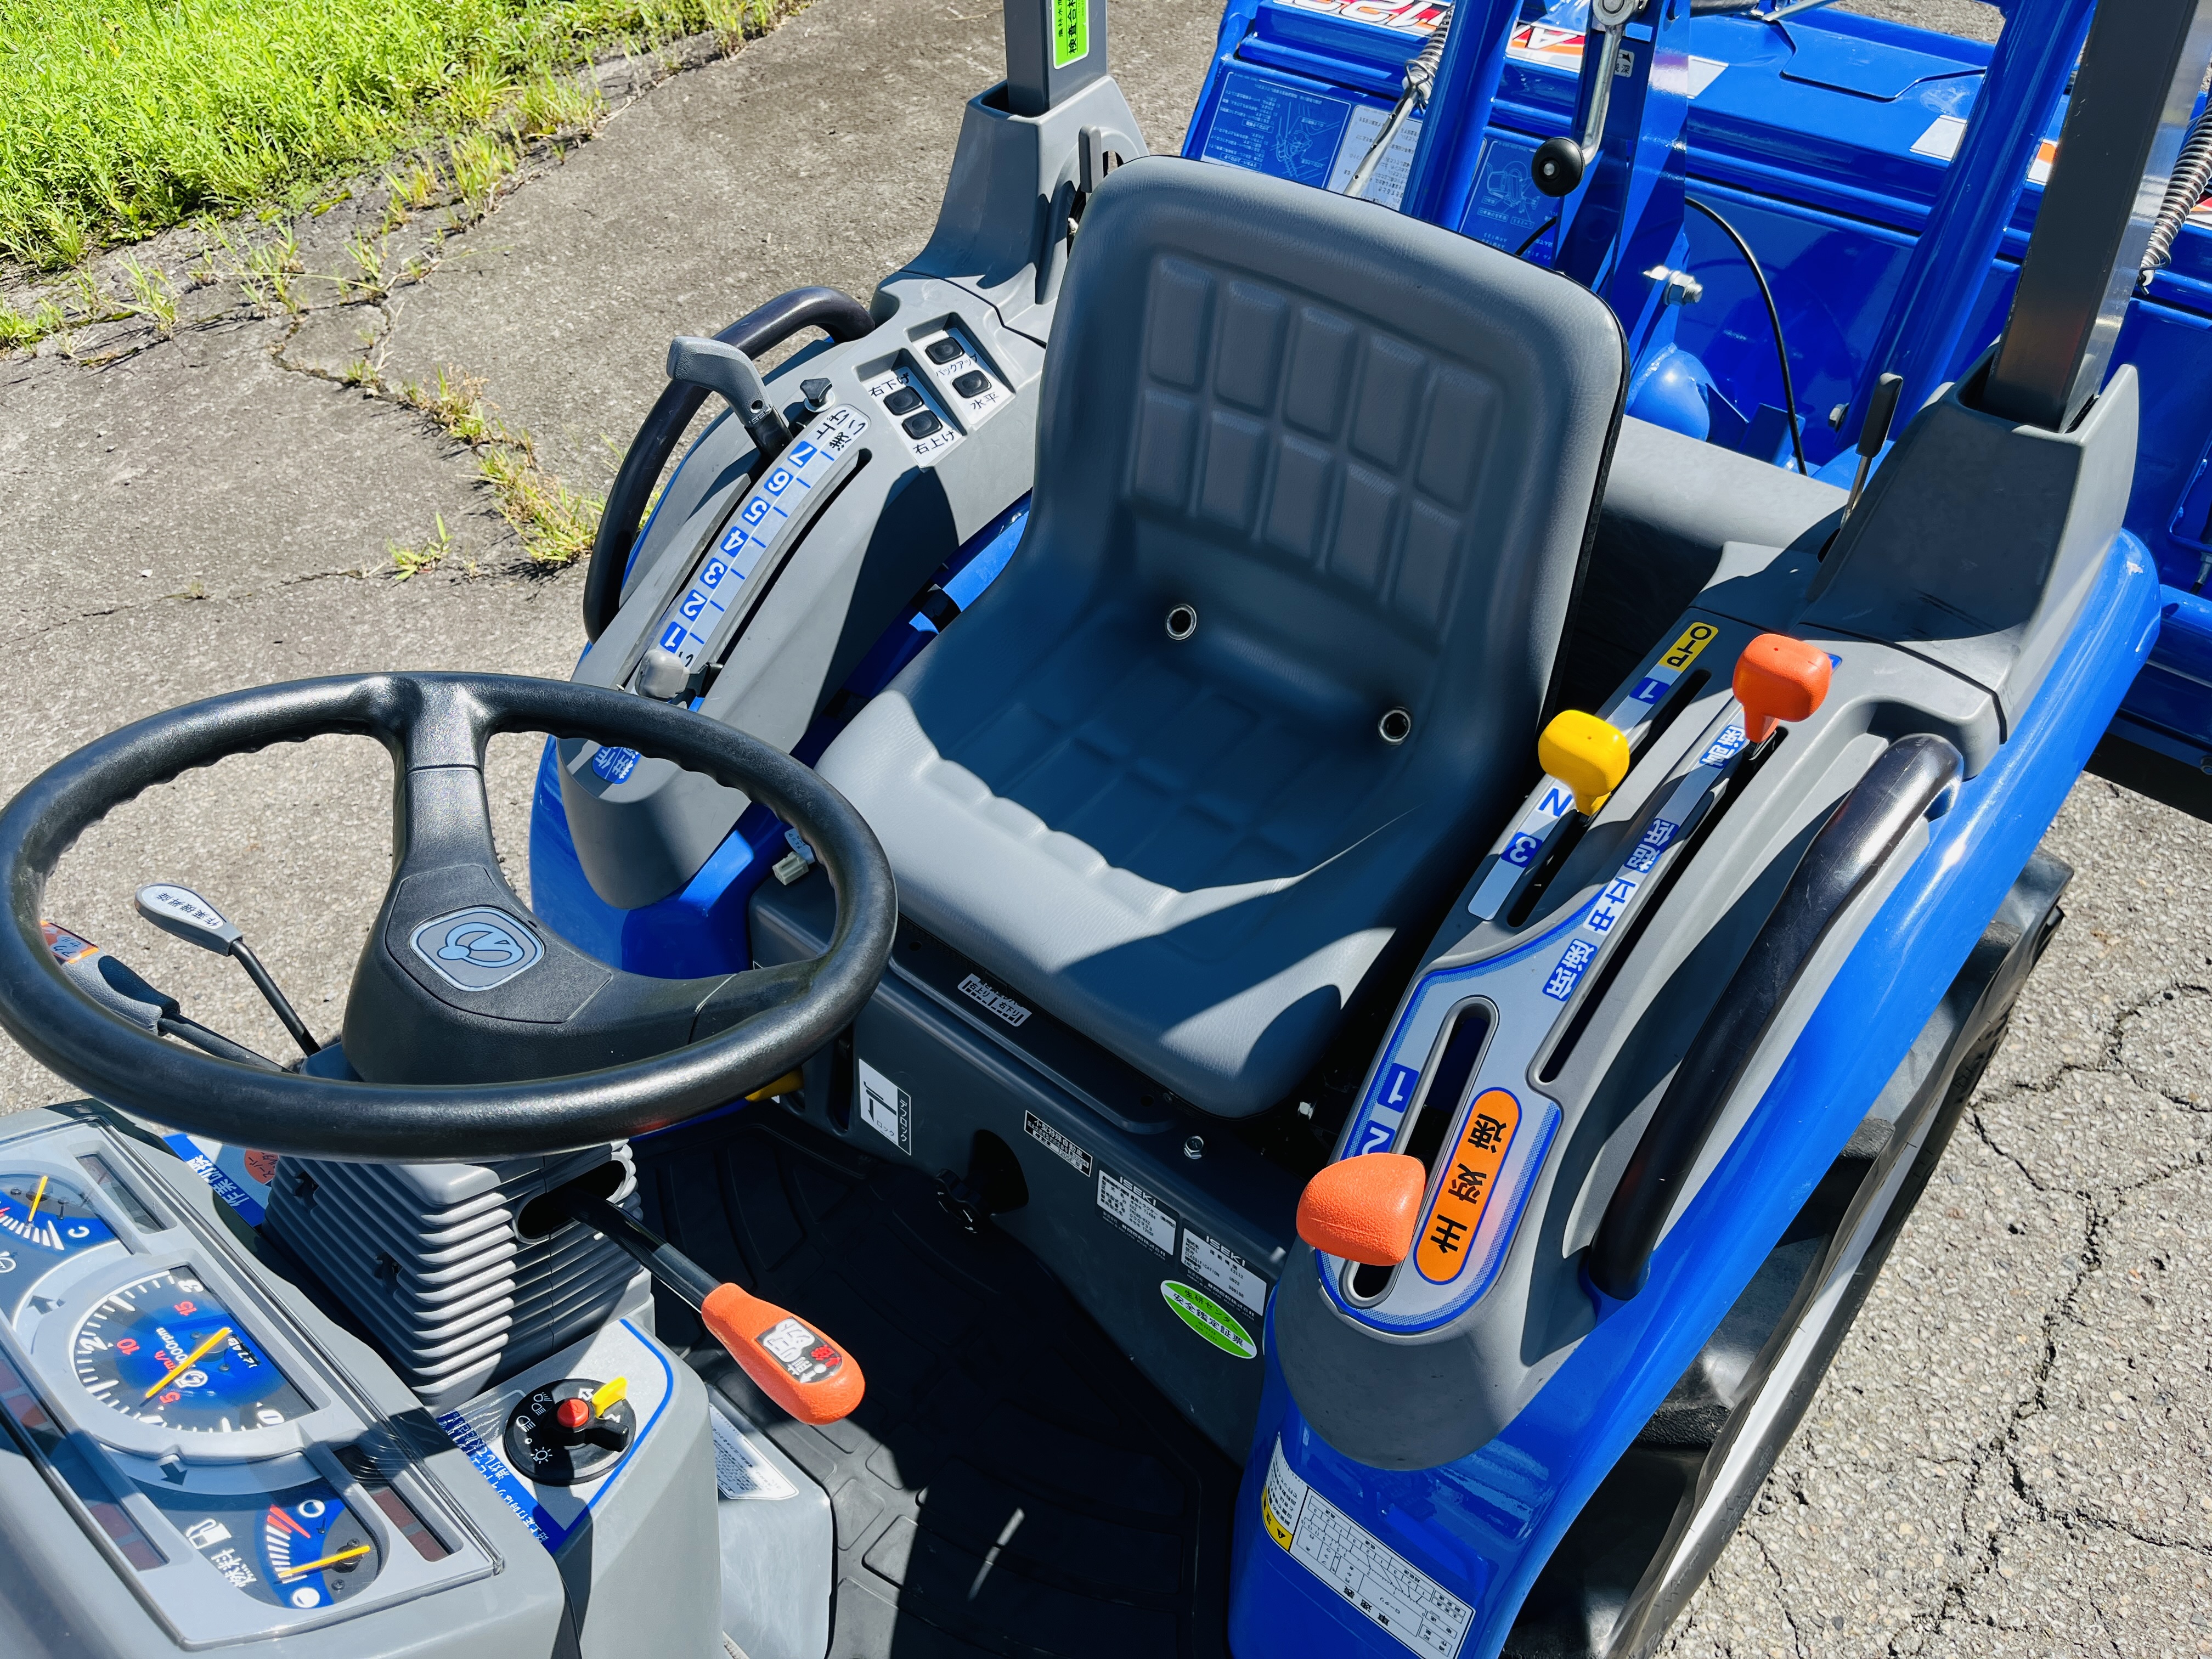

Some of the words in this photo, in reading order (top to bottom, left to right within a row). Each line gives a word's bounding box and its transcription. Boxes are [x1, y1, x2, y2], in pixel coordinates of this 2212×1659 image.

[935, 353, 978, 379] バックアップ
[868, 370, 911, 398] 右下げ
[969, 392, 1000, 411] 水平
[815, 410, 850, 441] 上げ
[789, 445, 814, 465] 7
[912, 430, 956, 456] 右上げ
[769, 472, 790, 492] 6
[745, 498, 768, 523] 5
[724, 529, 746, 551] 4
[702, 561, 725, 586] 3
[682, 596, 706, 617] 2
[664, 627, 685, 647] 1
[1669, 625, 1713, 668] PTO
[1637, 681, 1657, 701] 1
[1541, 789, 1572, 816] N
[1509, 836, 1537, 864] 3
[1590, 878, 1637, 932] 中立
[1545, 940, 1595, 1000] 低速
[968, 981, 990, 998] 右上り
[998, 1001, 1019, 1018] 右下り
[1388, 1071, 1406, 1104] 1
[1119, 1176, 1156, 1206] ISEKI
[1430, 1113, 1507, 1254] 主変速
[68, 1226, 90, 1238] C
[1206, 1235, 1245, 1267] ISEKI
[178, 1279, 204, 1293] 3
[174, 1301, 197, 1316] 15
[1172, 1290, 1244, 1349] 安全鑑定証票
[1183, 1286, 1239, 1334] 生研センター
[79, 1336, 109, 1351] 2
[116, 1338, 140, 1356] 10
[788, 1356, 813, 1376] 前
[159, 1391, 181, 1404] 5
[257, 1409, 285, 1424] 0
[211, 1548, 257, 1588] 燃料
